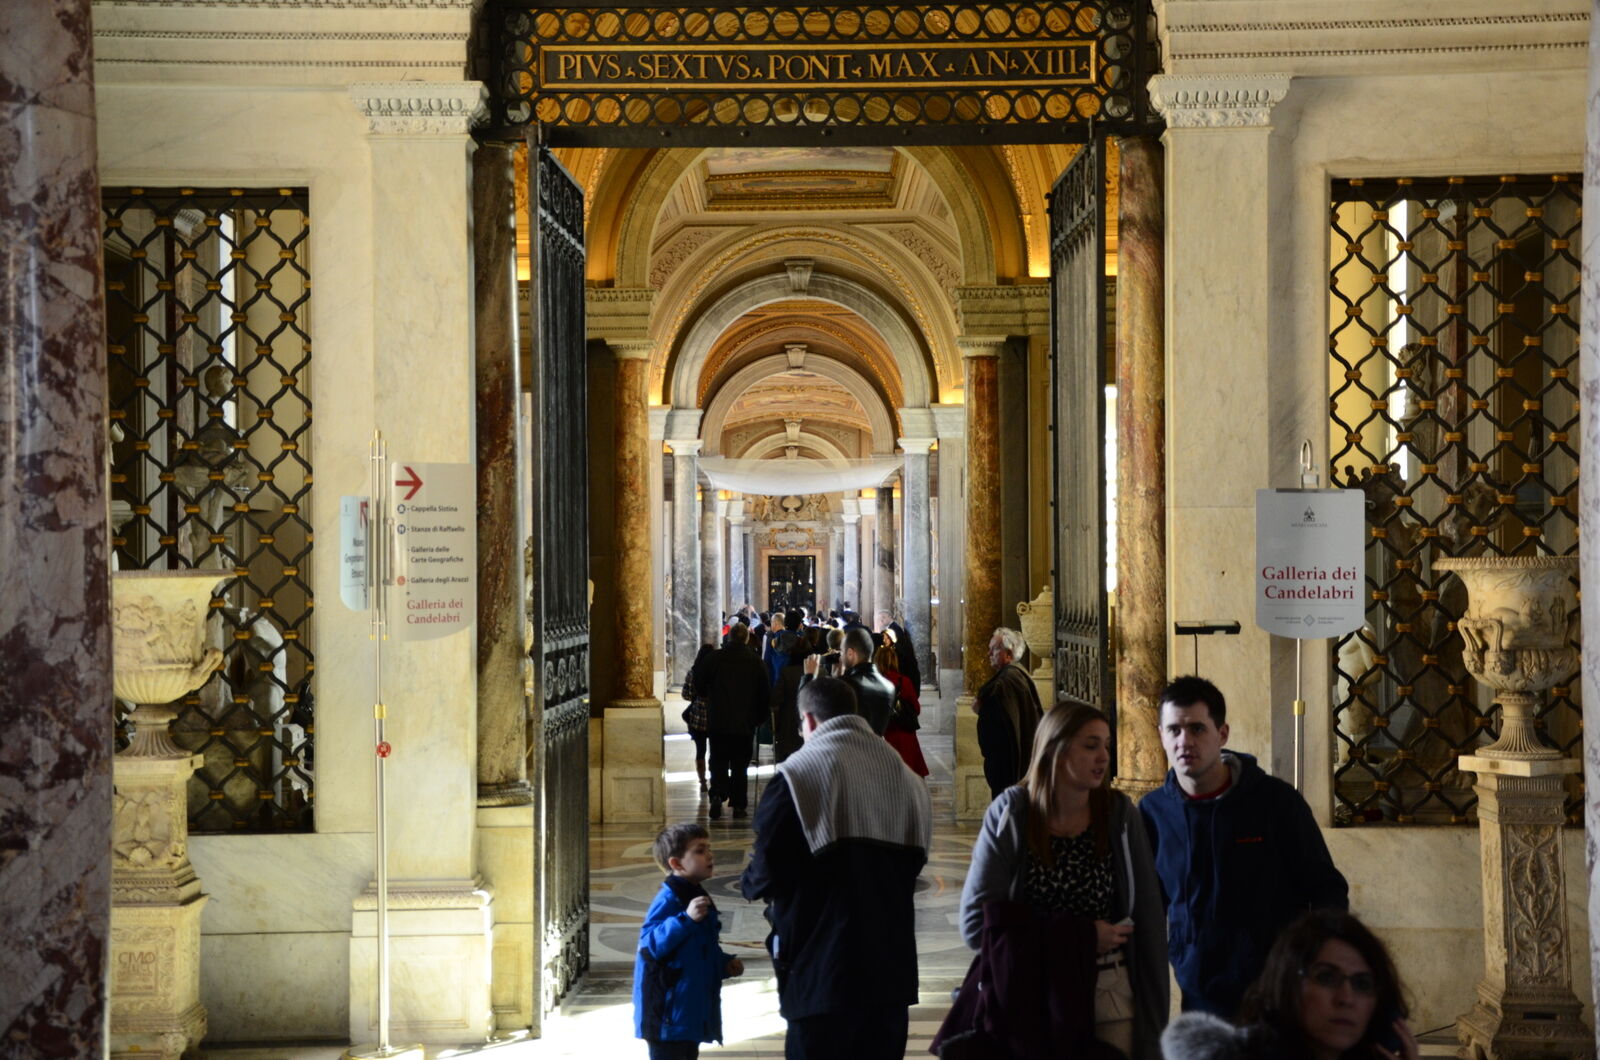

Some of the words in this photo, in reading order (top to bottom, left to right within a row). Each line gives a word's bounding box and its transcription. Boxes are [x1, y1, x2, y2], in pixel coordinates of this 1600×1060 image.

[557, 54, 621, 80] PIVS
[638, 54, 750, 80] SEXTVS
[767, 54, 852, 80] PONT
[868, 52, 941, 78] MAX
[961, 50, 1009, 76] AN
[1020, 49, 1080, 75] XIII
[411, 505, 437, 513] Cappella
[428, 556, 464, 564] Geografiche
[1262, 566, 1327, 580] Galleria
[1332, 566, 1357, 580] dei
[1264, 585, 1354, 600] Candelabri
[407, 599, 446, 610] Galleria
[448, 598, 464, 609] dei
[407, 613, 460, 624] Candelabri
